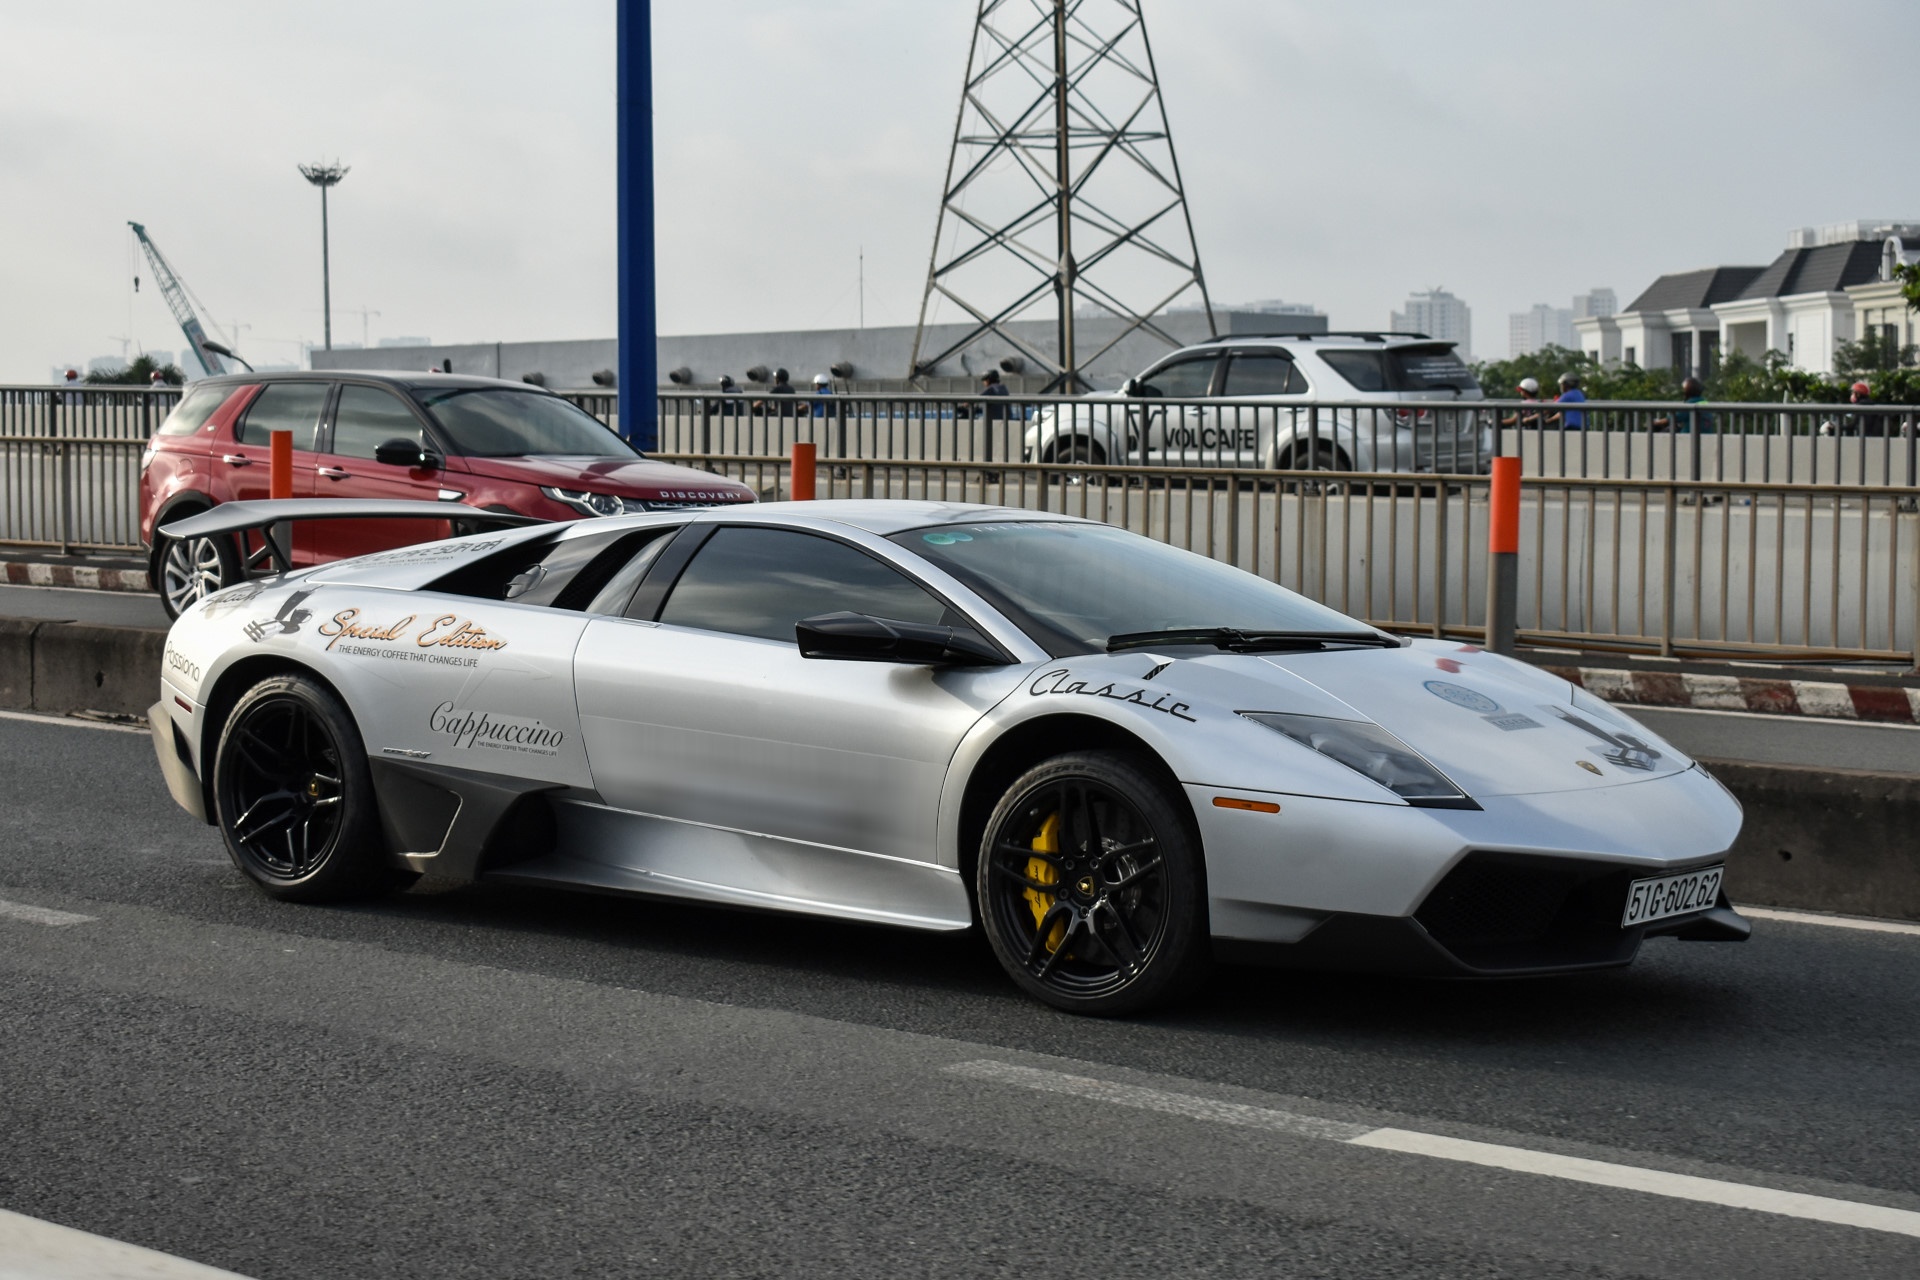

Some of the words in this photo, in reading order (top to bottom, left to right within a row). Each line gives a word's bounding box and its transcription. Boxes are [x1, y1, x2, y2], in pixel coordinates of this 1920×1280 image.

[660, 490, 742, 500] DISCOVERY
[318, 607, 418, 652] Special
[416, 613, 508, 651] Edition
[164, 640, 201, 683] Passiona
[338, 644, 353, 654] THE
[353, 645, 381, 658] ENERGY
[382, 649, 409, 661] COFFEE
[409, 652, 428, 663] THAT
[428, 654, 463, 667] CHANGES
[463, 657, 479, 669] LIFE
[1029, 668, 1197, 723] Classic
[429, 700, 565, 749] Cappuccino
[485, 741, 502, 749] ENERGY
[502, 744, 518, 752] COFFEE
[529, 748, 549, 756] CHANGES
